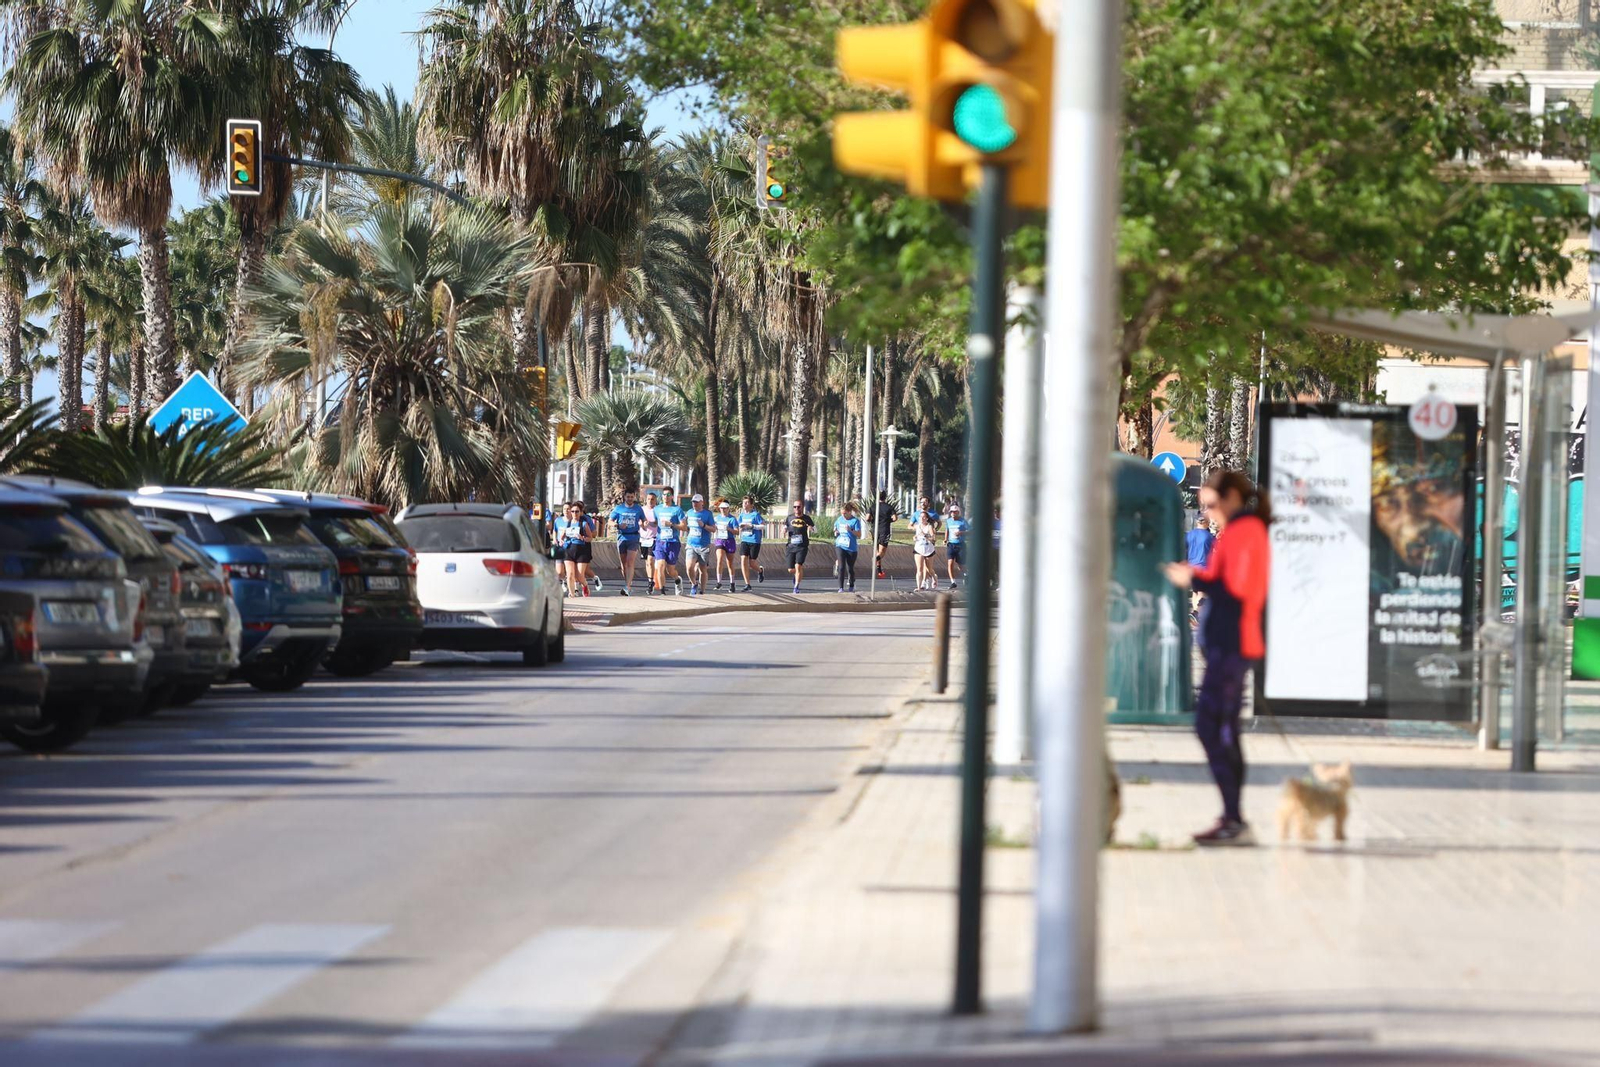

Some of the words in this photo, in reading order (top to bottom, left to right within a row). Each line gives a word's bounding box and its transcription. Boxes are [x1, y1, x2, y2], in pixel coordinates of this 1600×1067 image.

[181, 407, 214, 421] RED
[1414, 401, 1455, 429] 40
[1397, 571, 1417, 587] Te
[1380, 591, 1462, 609] perdiendo
[1374, 609, 1391, 625] la
[1392, 609, 1438, 626] mitad
[1439, 611, 1462, 626] de
[1380, 628, 1396, 644] la
